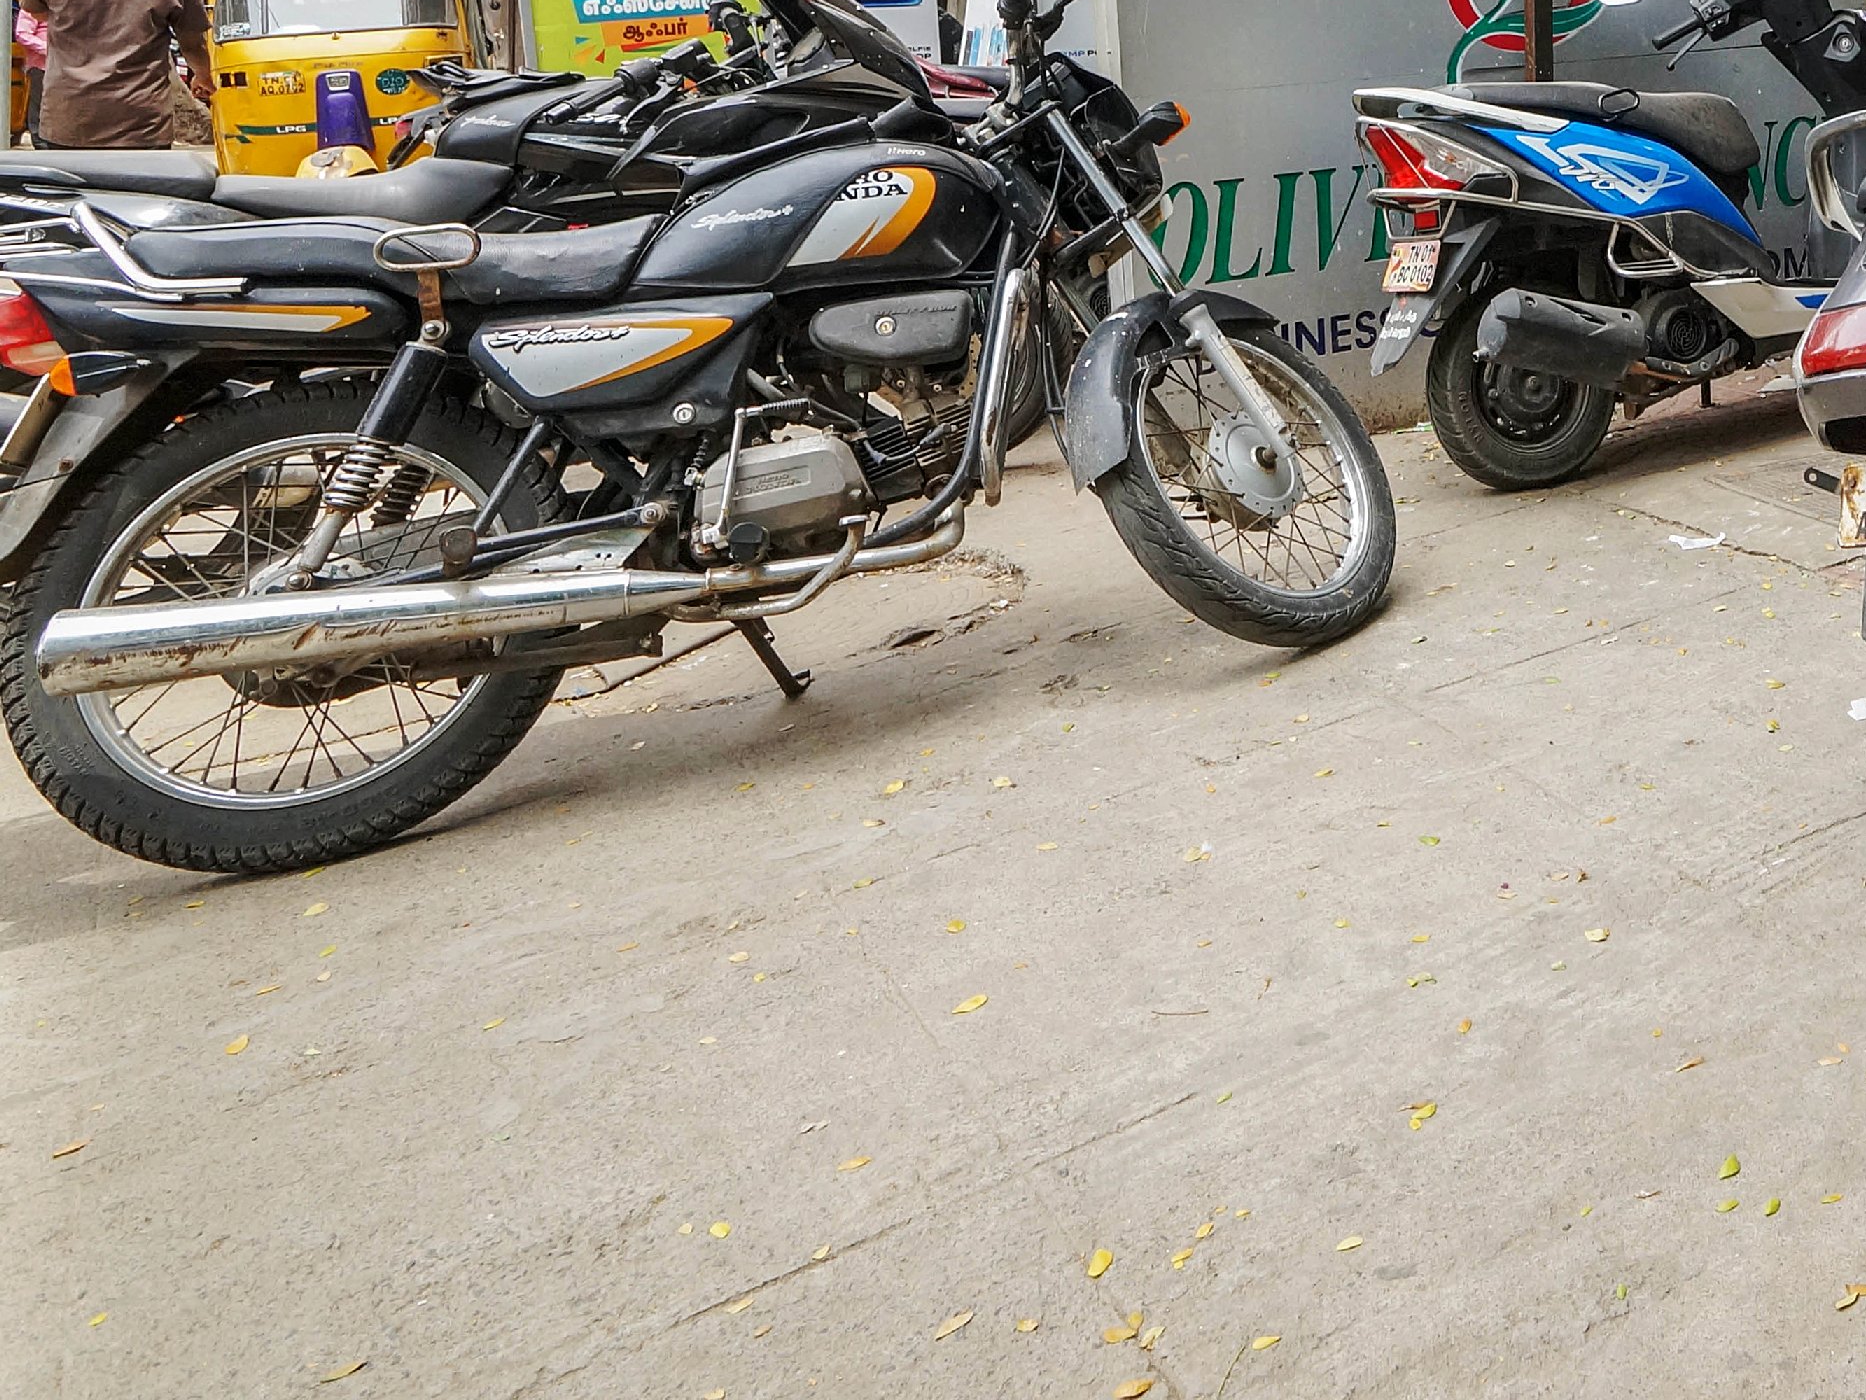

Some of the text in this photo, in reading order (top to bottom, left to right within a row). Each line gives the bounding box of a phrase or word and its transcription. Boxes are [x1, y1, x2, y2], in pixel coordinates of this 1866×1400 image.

[379, 117, 397, 125] LP
[276, 125, 307, 134] LPG
[840, 183, 909, 201] NDA
[1408, 245, 1420, 263] TN
